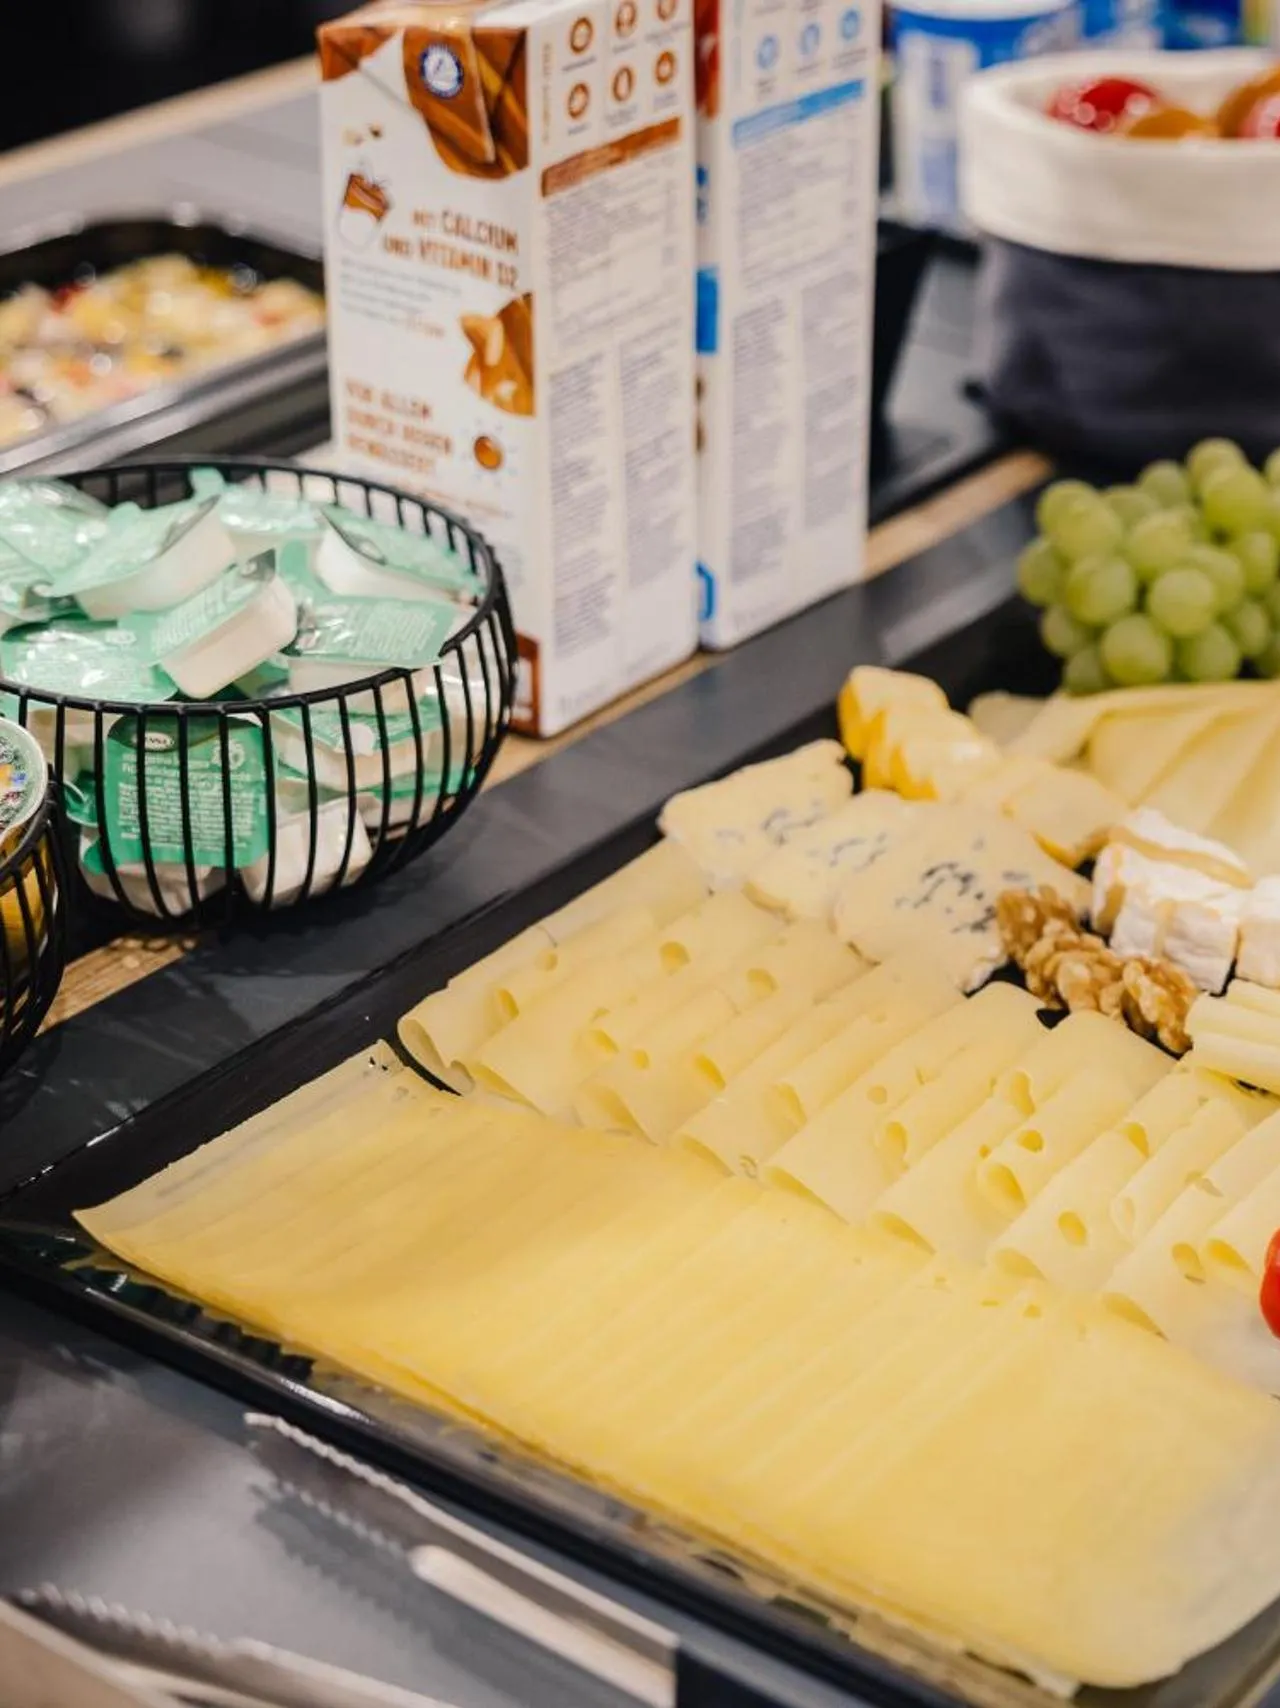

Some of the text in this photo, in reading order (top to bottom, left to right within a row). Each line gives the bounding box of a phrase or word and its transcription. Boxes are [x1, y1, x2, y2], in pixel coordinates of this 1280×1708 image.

[441, 209, 519, 253] CALCIUM
[382, 233, 411, 258] UND
[419, 236, 492, 278] VITAMIN
